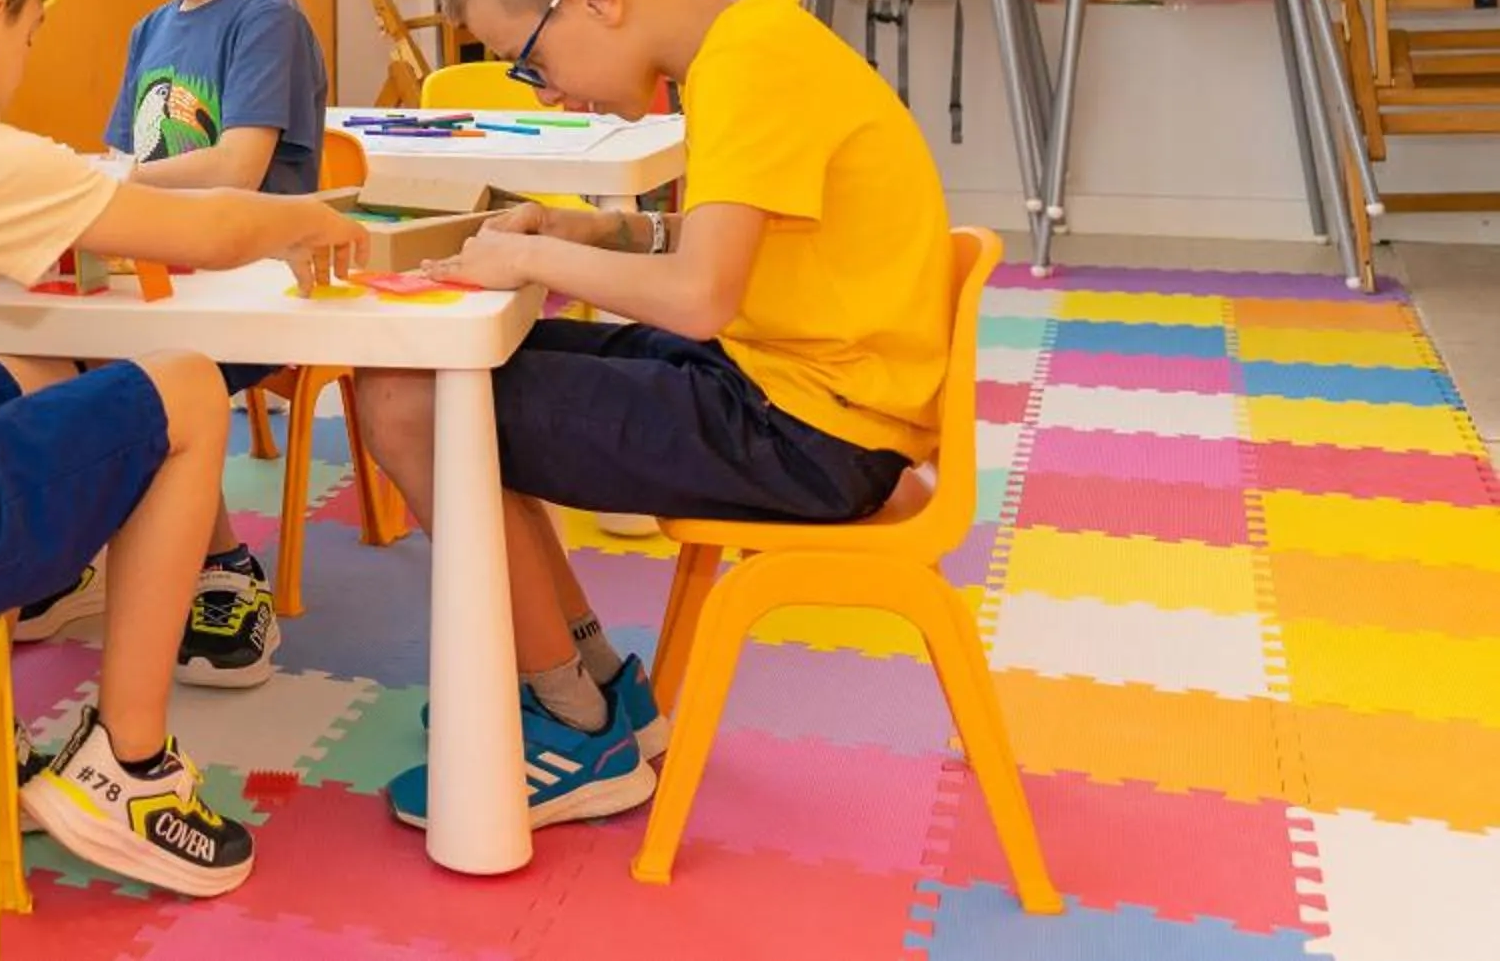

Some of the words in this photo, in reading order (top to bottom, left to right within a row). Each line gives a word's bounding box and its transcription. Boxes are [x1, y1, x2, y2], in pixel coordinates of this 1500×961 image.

[573, 621, 601, 641] um
[76, 764, 123, 803] #78
[154, 809, 216, 863] COVERI
